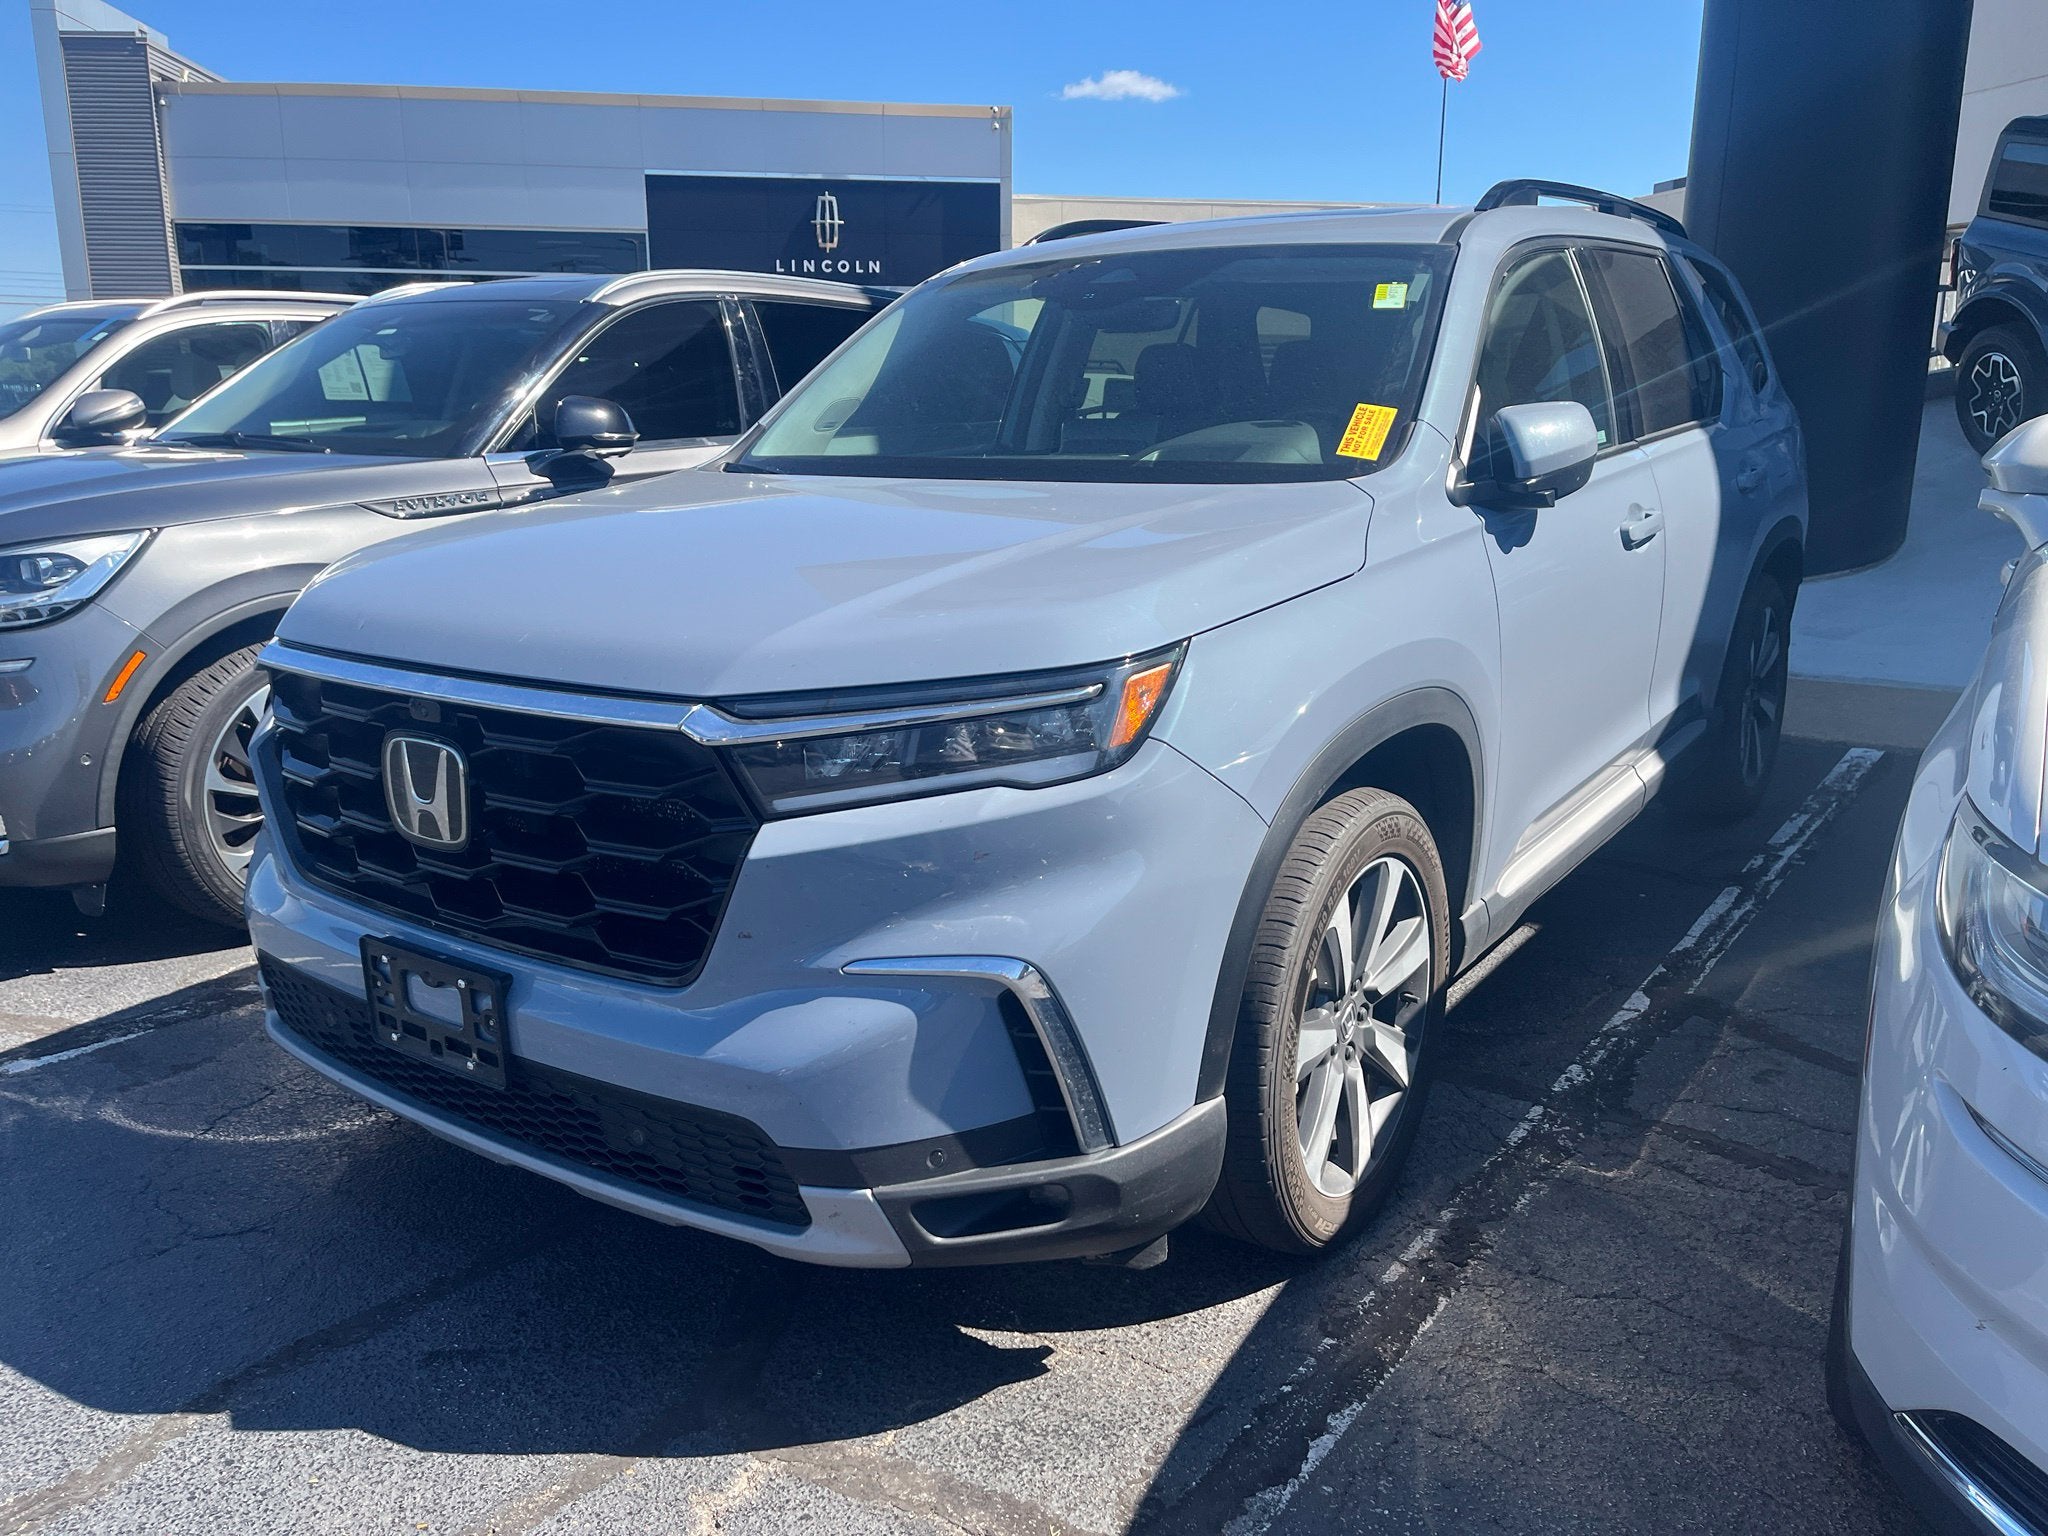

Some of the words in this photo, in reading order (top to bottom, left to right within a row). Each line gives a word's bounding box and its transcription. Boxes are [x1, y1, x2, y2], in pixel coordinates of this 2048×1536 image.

[776, 259, 882, 274] LINCOLN
[1340, 436, 1355, 453] THIS
[1348, 406, 1368, 435] VEHICLE
[1352, 440, 1363, 453] NOT
[1358, 426, 1369, 439] FOR
[1365, 409, 1376, 425] SALE
[393, 491, 489, 512] AVIATOR
